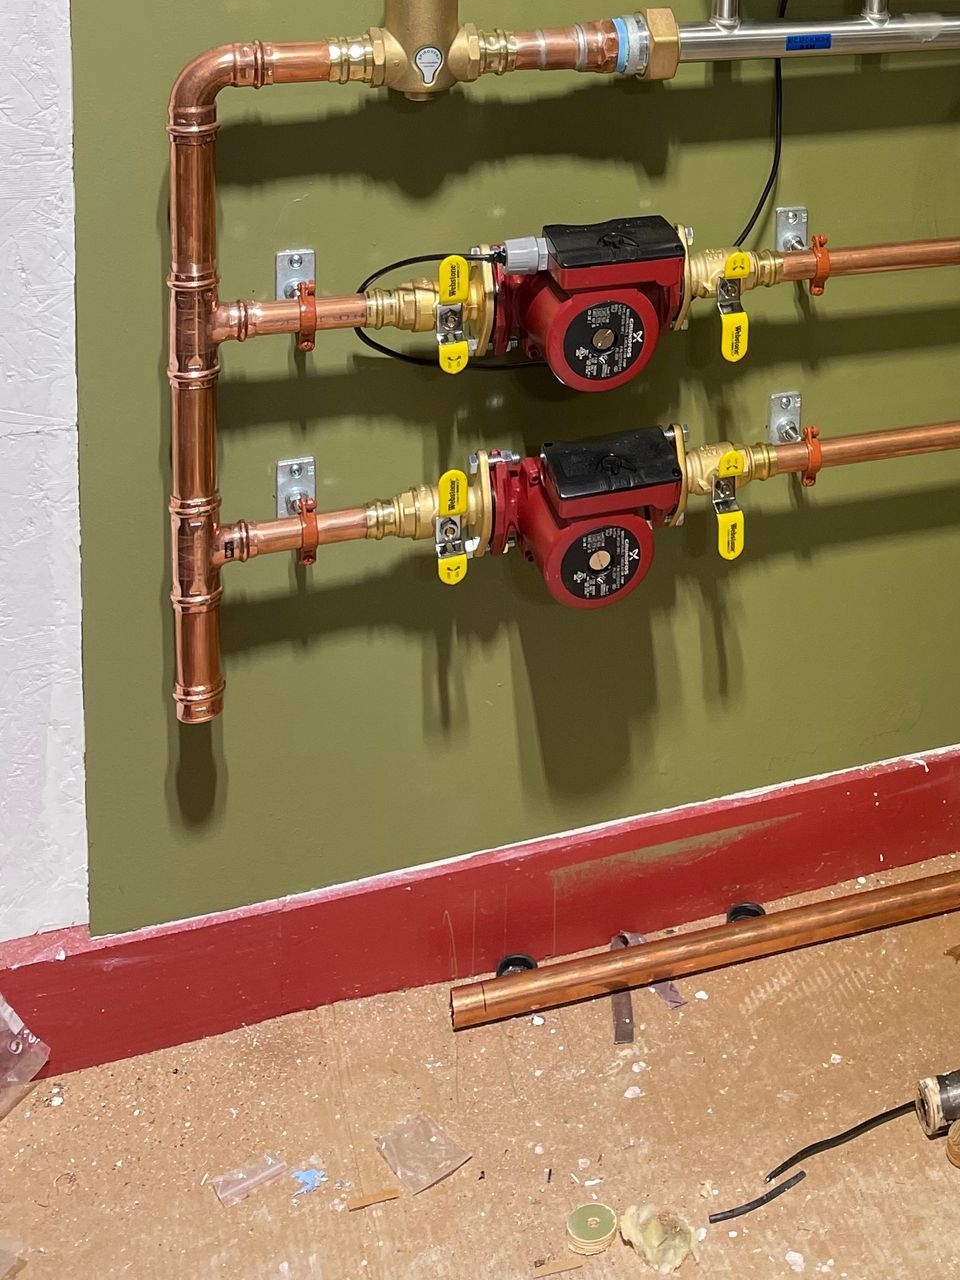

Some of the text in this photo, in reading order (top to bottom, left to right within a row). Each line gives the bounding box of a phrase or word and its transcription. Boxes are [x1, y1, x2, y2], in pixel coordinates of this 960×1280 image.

[449, 264, 457, 297] Webstone
[627, 318, 635, 358] GRUNDFOS
[447, 478, 456, 512] Webstone
[730, 522, 738, 553] Webstone
